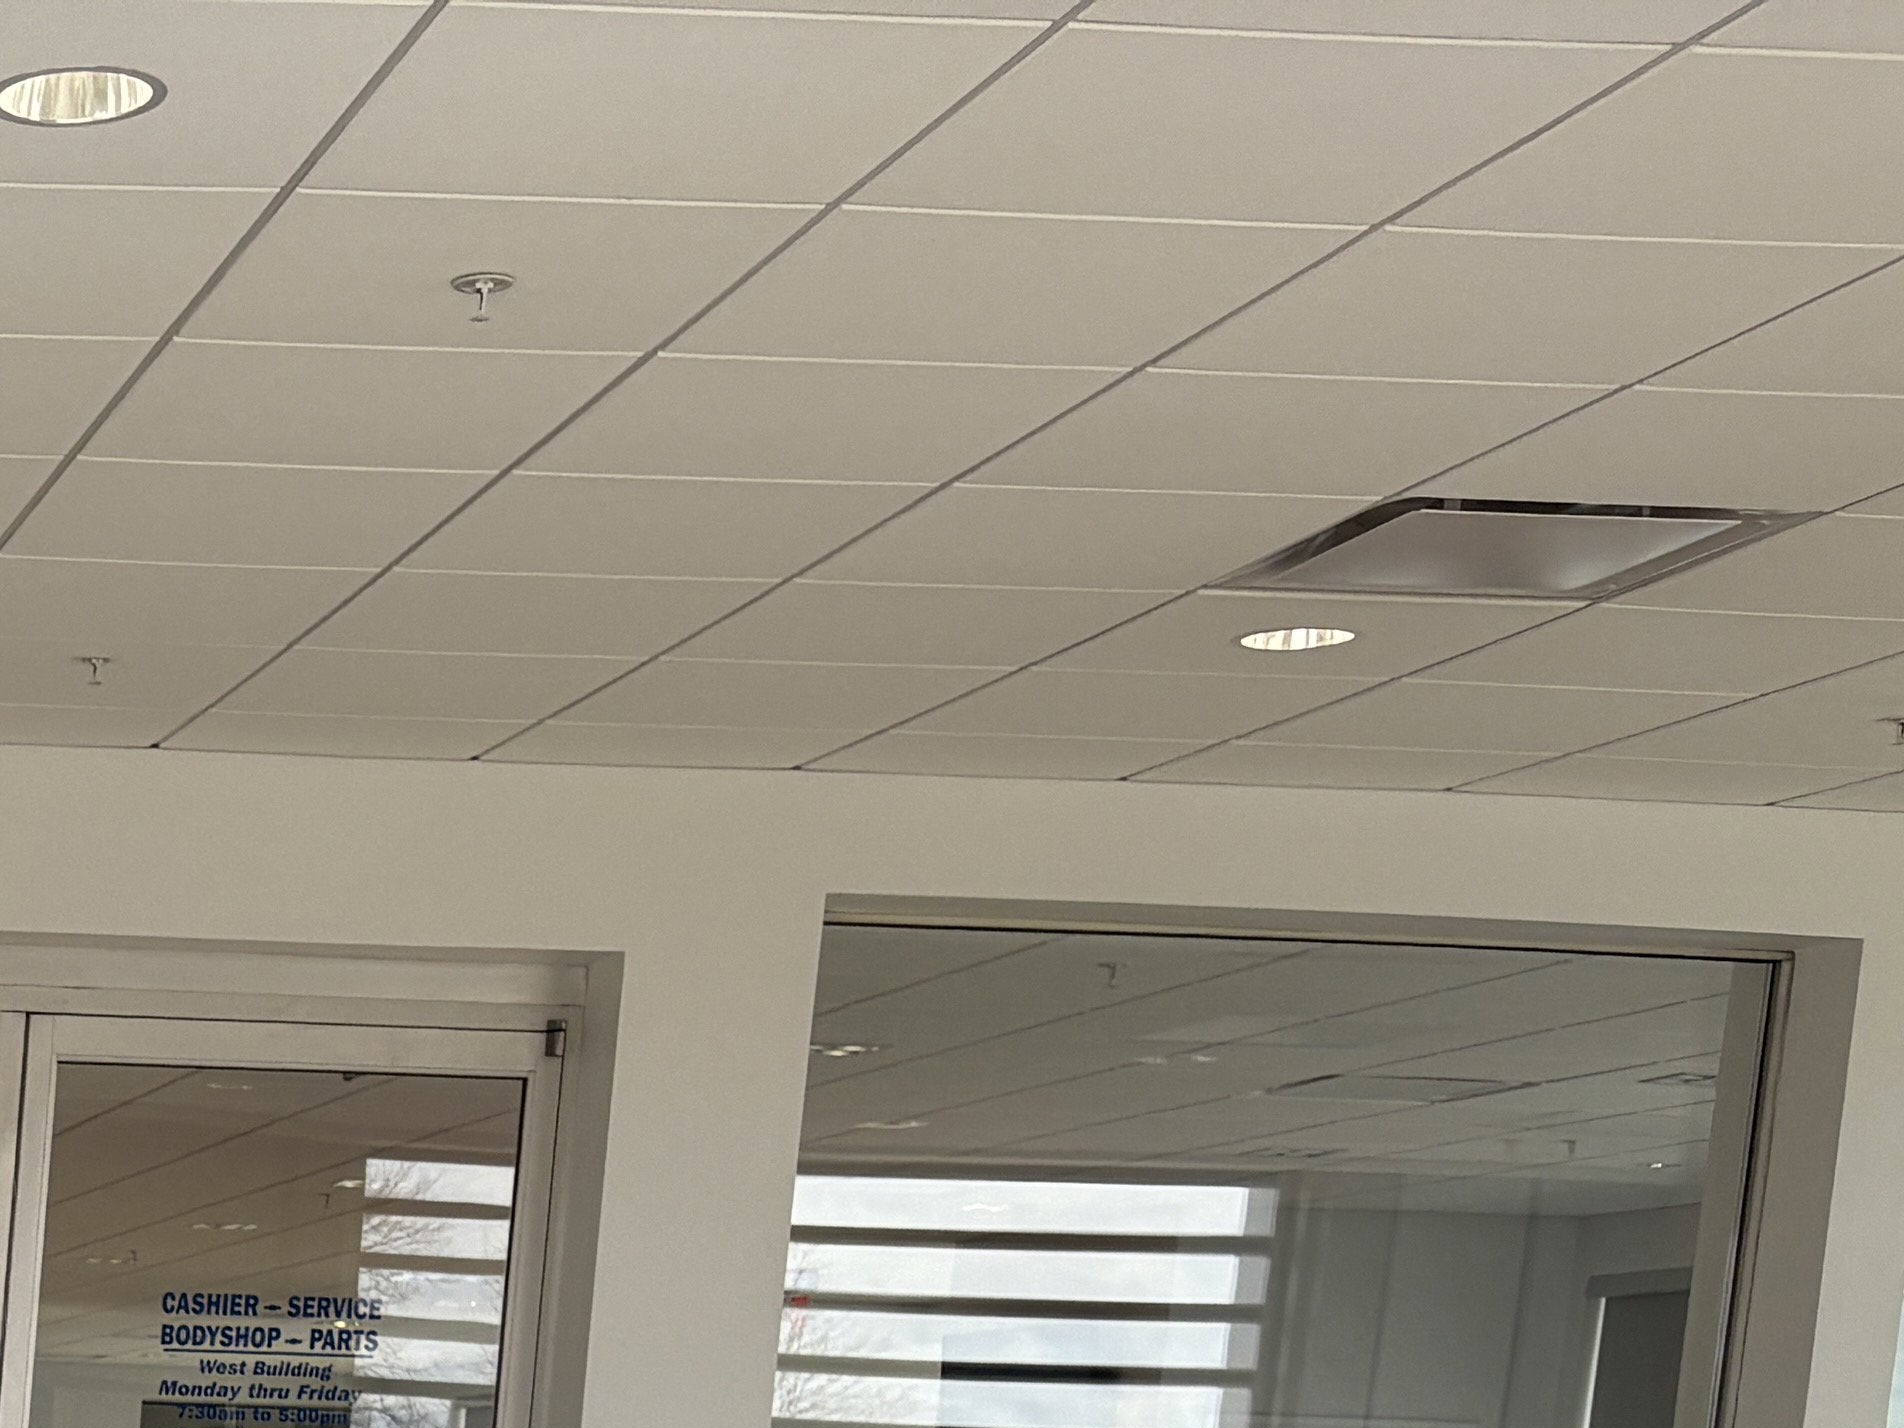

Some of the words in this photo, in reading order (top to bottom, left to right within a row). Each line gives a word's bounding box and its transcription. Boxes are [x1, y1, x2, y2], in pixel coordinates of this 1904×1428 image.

[161, 1292, 259, 1316] CASHIER
[287, 1296, 382, 1320] SERVICE
[160, 1324, 281, 1348] BODYSHOP
[309, 1328, 379, 1351] PARTS
[199, 1359, 246, 1376] West
[253, 1361, 333, 1381] Building
[158, 1380, 241, 1401] Monday
[248, 1383, 290, 1399] thru
[297, 1384, 363, 1406] Friday
[253, 1407, 271, 1421] to
[278, 1407, 349, 1426] 5:00pm
